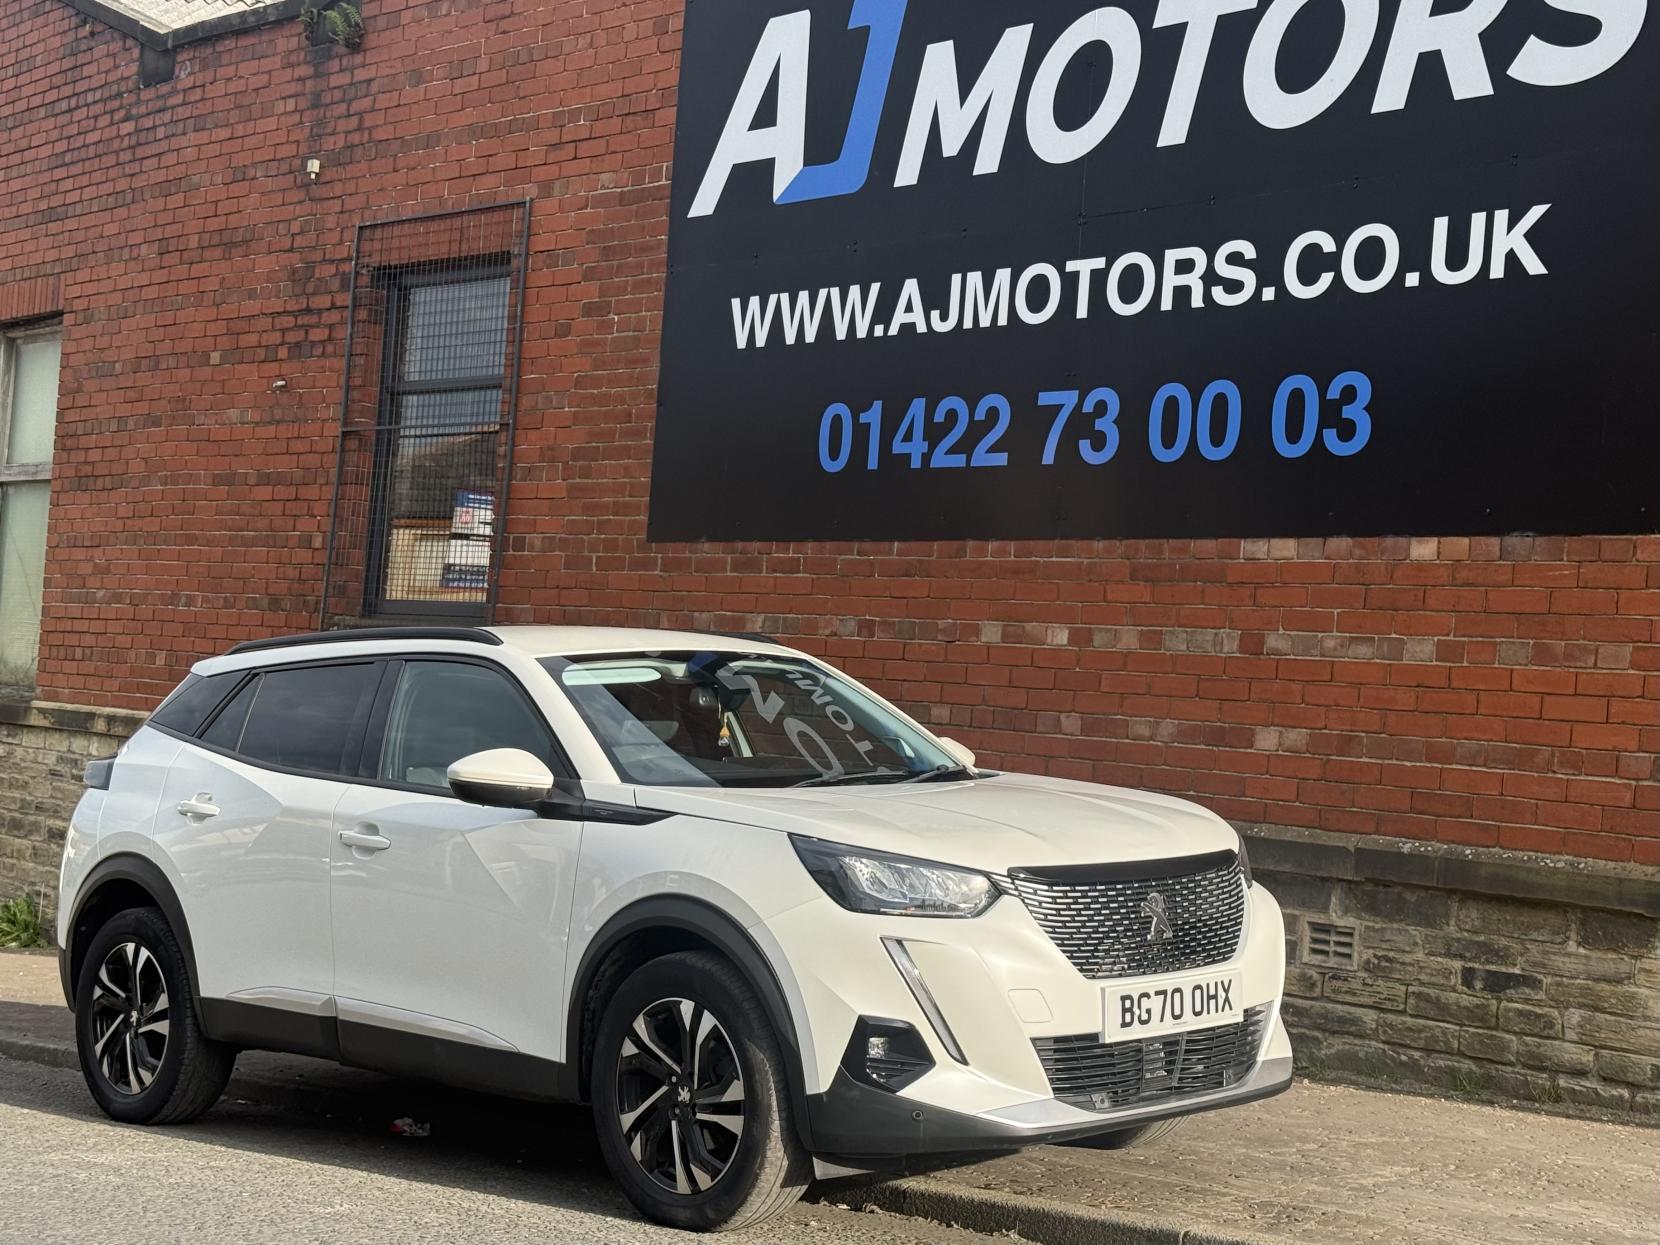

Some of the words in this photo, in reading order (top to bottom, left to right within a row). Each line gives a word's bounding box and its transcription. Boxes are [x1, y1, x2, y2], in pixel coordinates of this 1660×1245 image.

[687, 0, 908, 219] AJ
[893, 0, 1648, 188] MOTORS
[730, 203, 1552, 350] WWW.AJMOTORS.CO.UK
[818, 393, 1011, 473] 01422
[1037, 386, 1120, 466] 73
[1148, 379, 1242, 463] 00
[1271, 370, 1373, 460] 03
[1120, 987, 1184, 1029] BG70
[1192, 978, 1233, 1017] OHX
